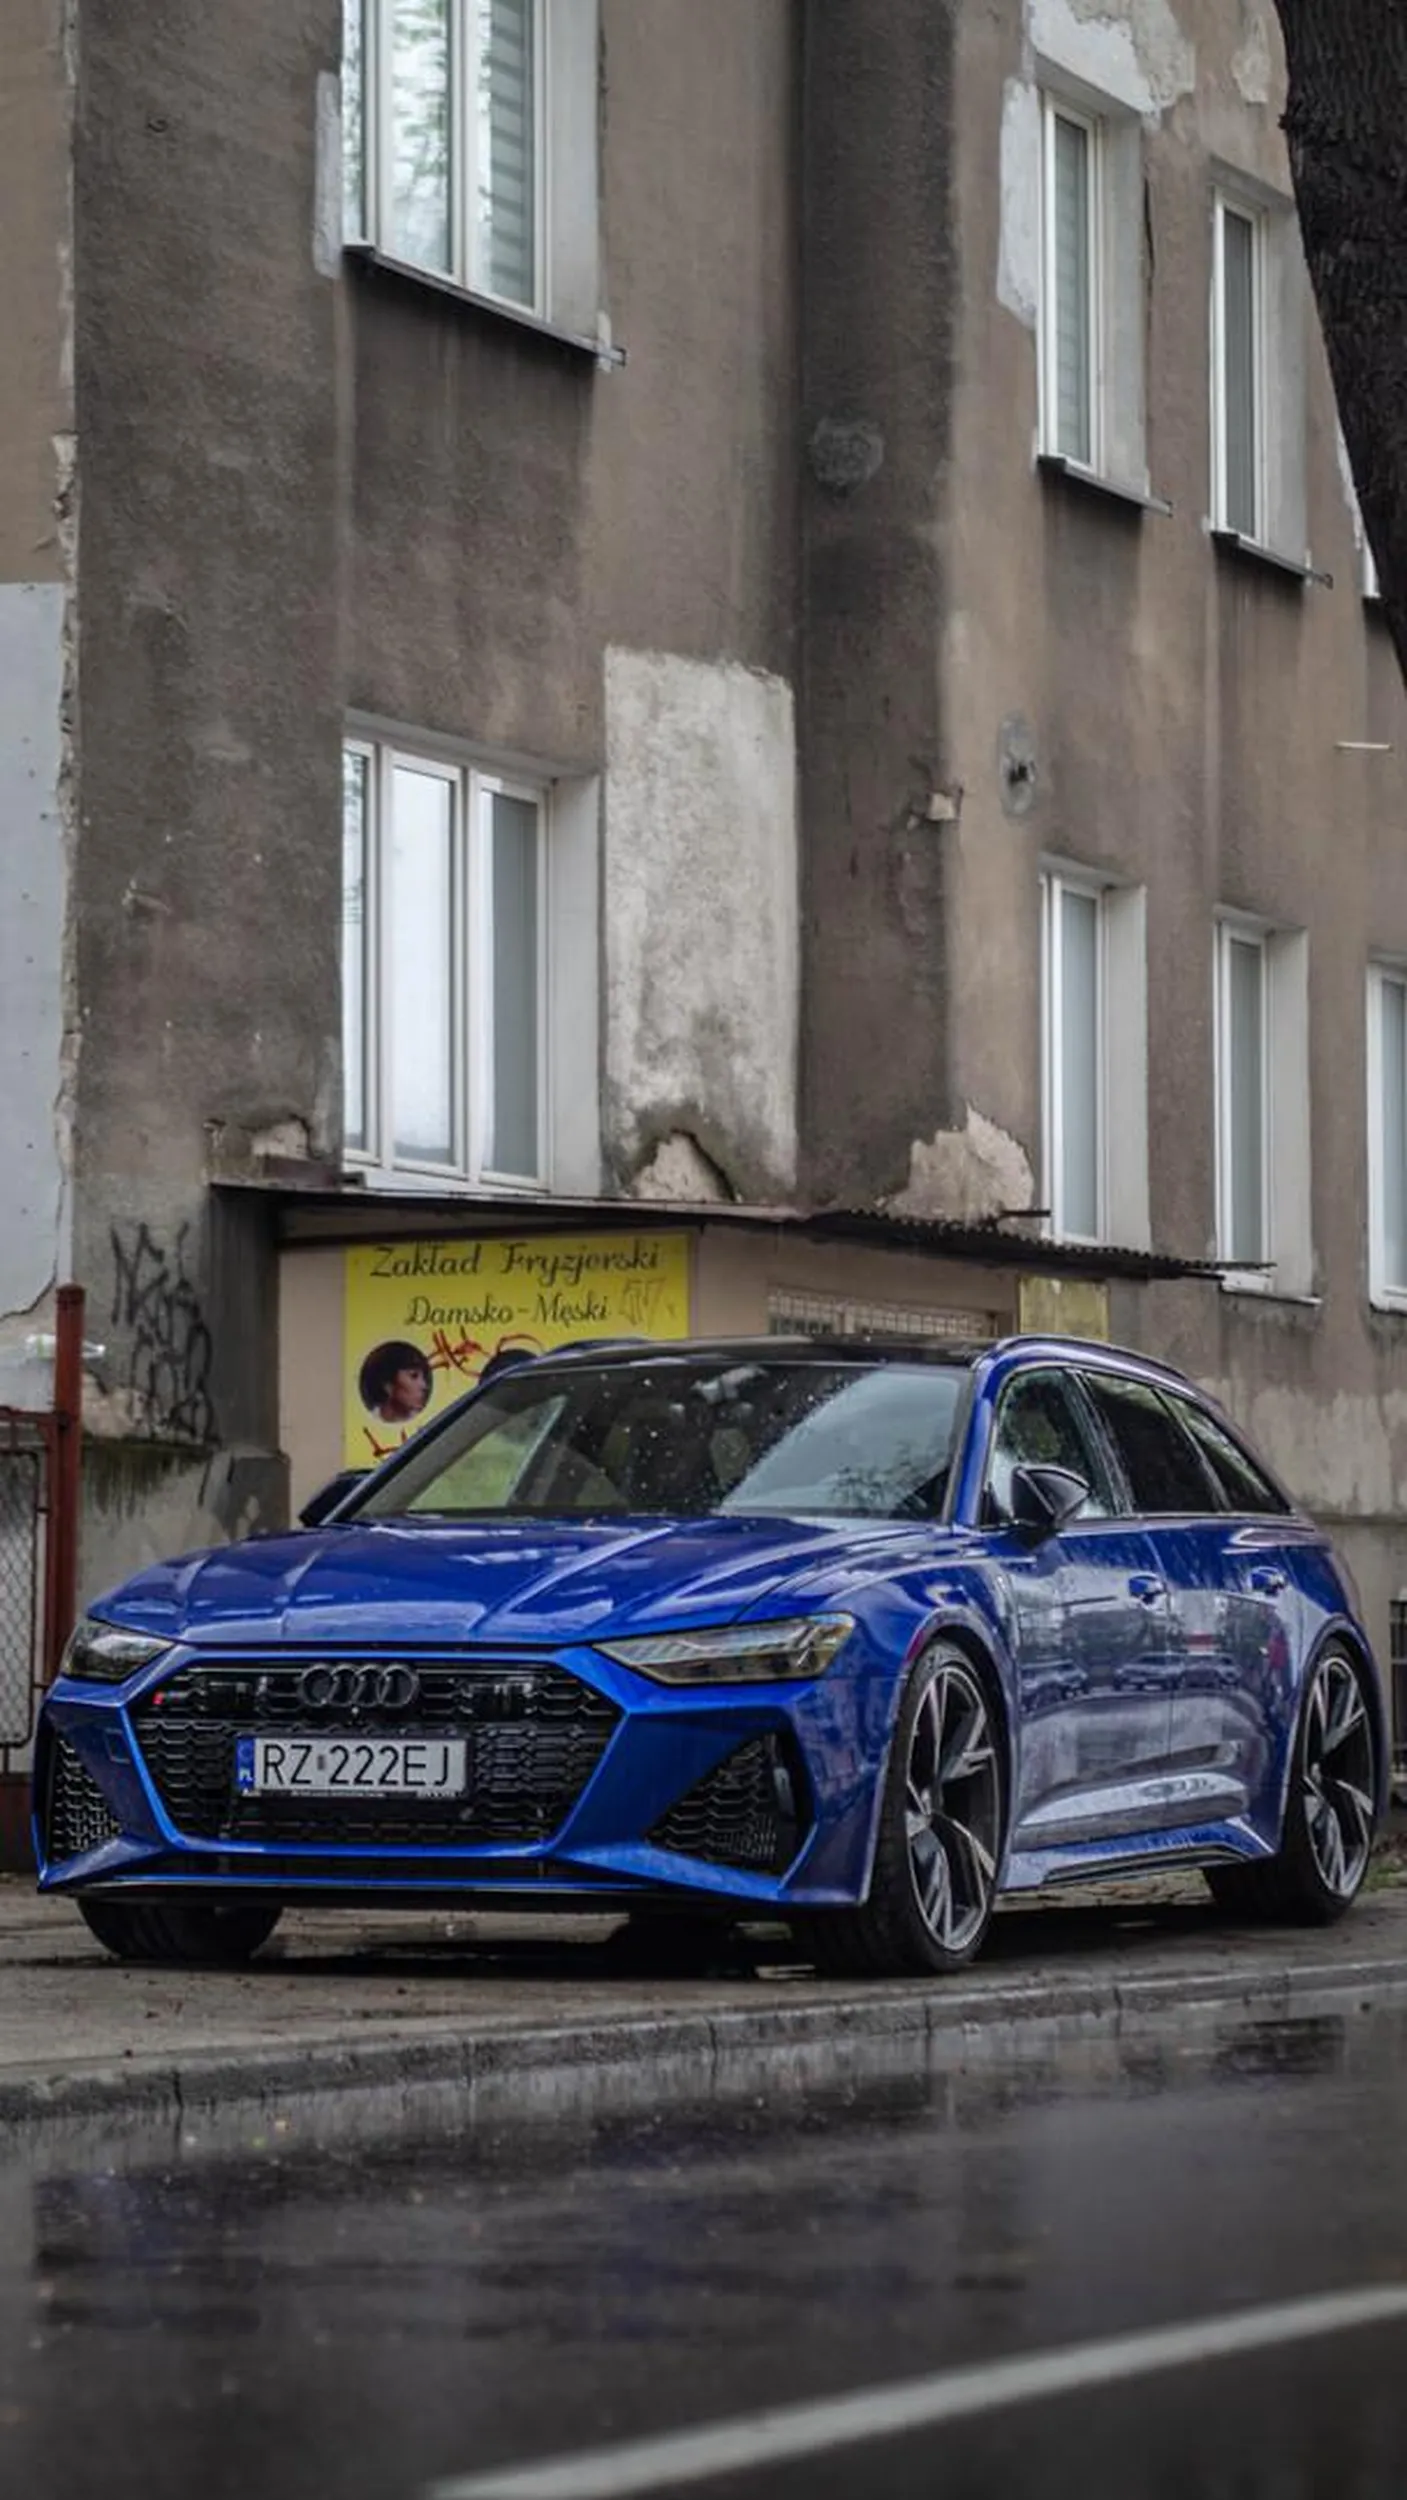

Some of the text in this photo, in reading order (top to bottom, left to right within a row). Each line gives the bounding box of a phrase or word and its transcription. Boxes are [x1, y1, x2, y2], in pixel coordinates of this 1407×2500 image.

[369, 1240, 482, 1278] Zakład
[263, 1744, 450, 1786] RZ 222EJ
